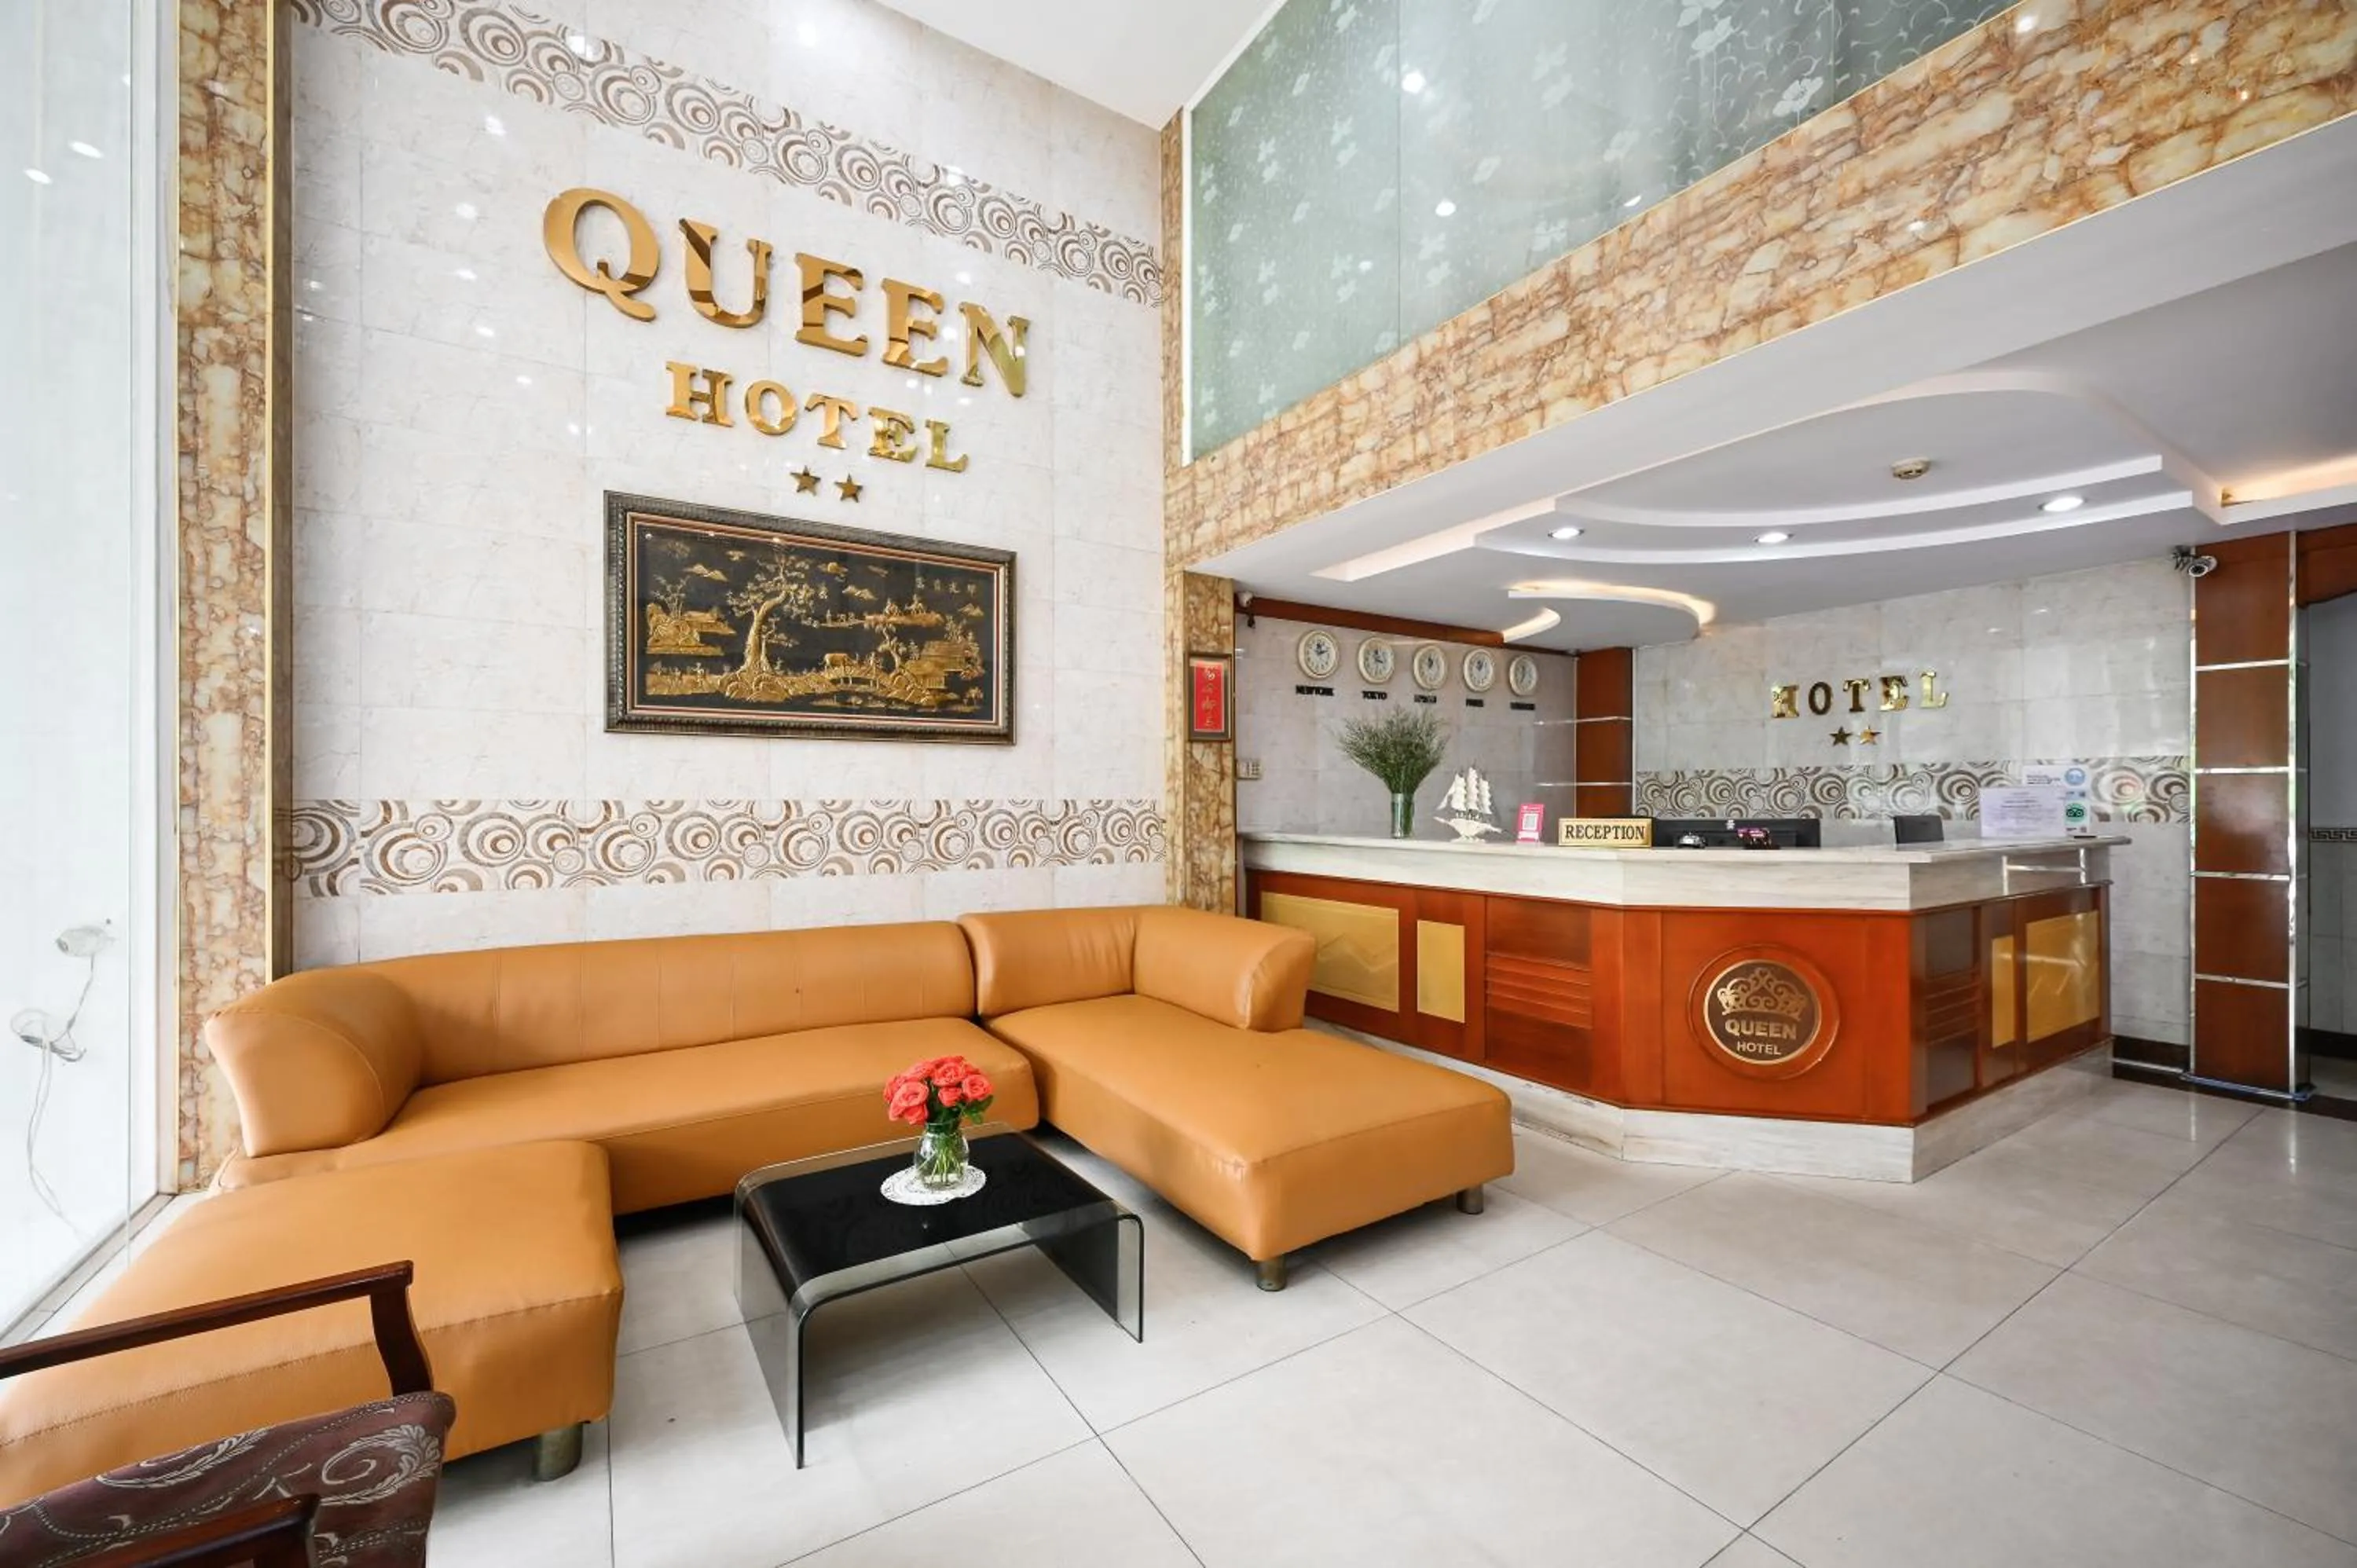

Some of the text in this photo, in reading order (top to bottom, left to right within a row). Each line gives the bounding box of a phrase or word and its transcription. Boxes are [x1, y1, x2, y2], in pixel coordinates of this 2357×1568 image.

[543, 187, 1031, 397] QUEEN
[665, 361, 969, 473] HOTEL
[1771, 669, 1949, 719] HOTEL
[1564, 824, 1645, 841] RECEPTION
[1725, 1019, 1798, 1040] QUEEN
[1736, 1042, 1782, 1056] HOTEL
